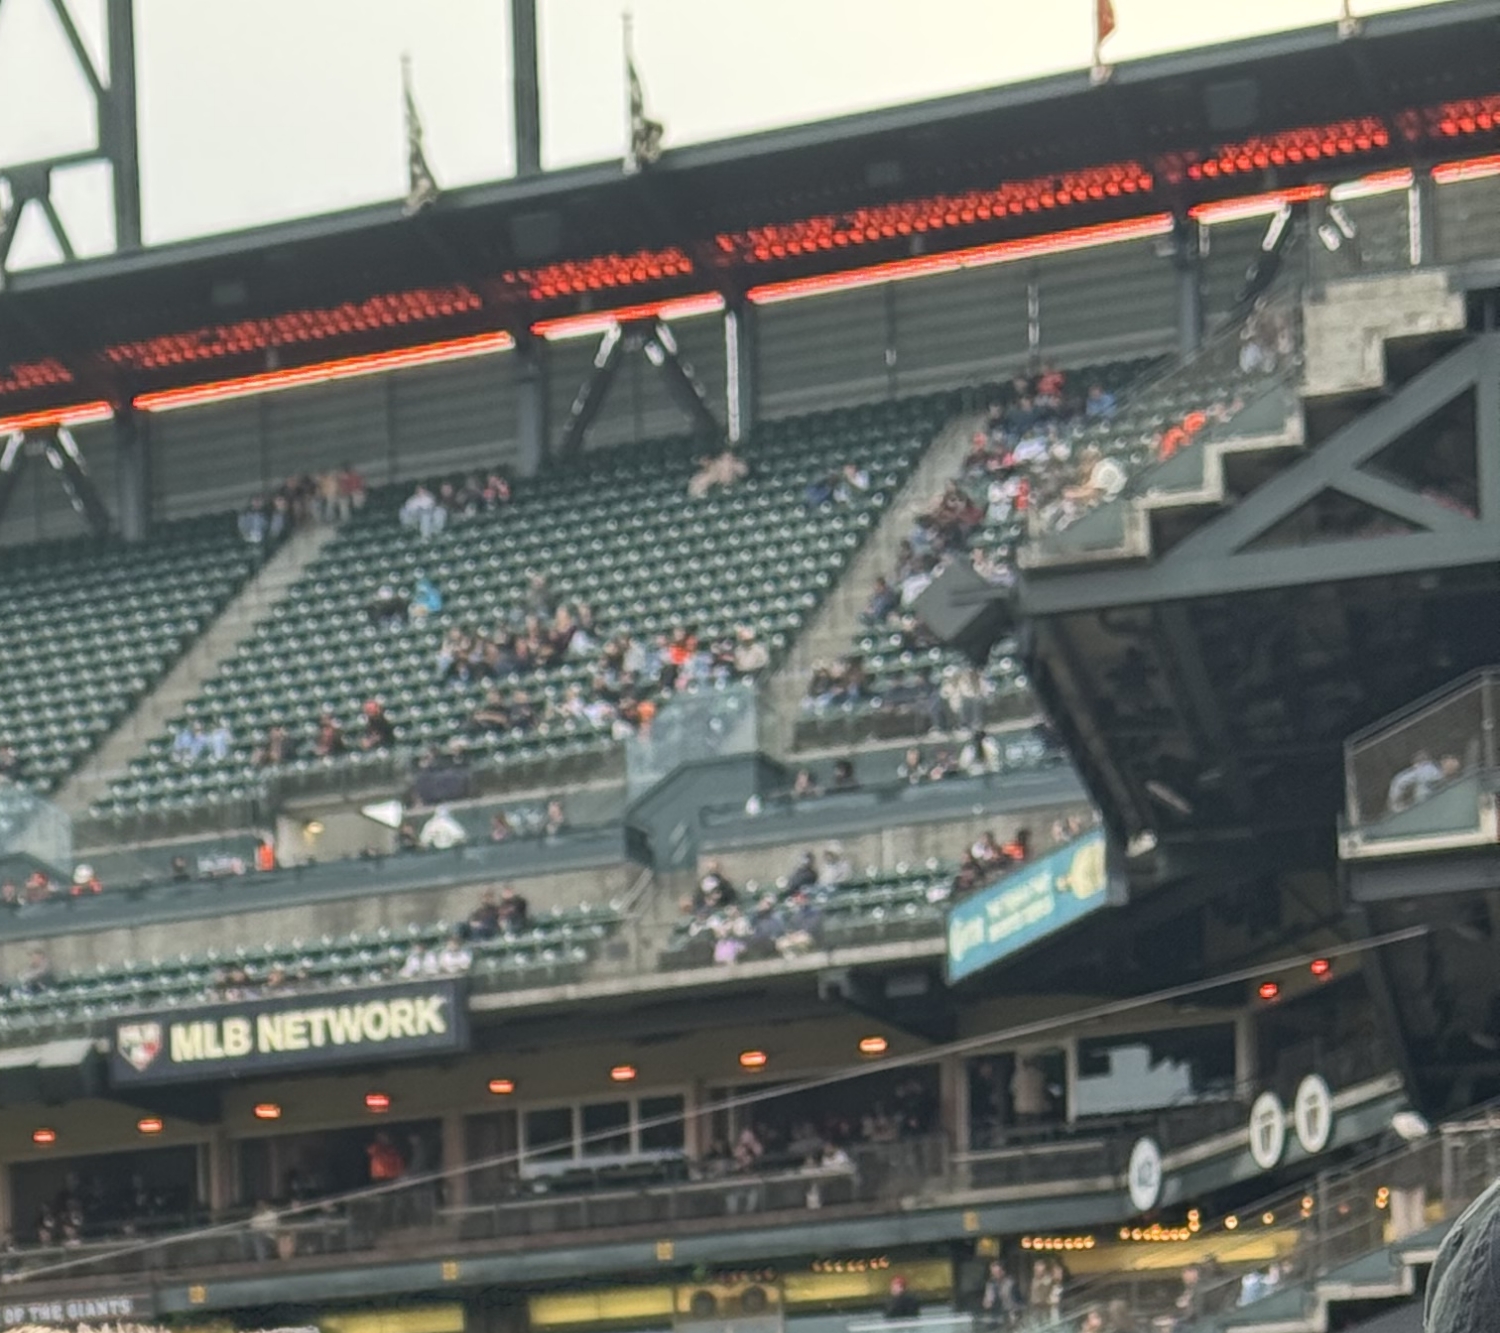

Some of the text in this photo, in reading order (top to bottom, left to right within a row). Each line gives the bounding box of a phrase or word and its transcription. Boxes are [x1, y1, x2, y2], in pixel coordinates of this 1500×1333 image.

[170, 1017, 252, 1062] MLB
[257, 995, 447, 1053] NETWORK
[66, 1297, 134, 1319] GIANTS
